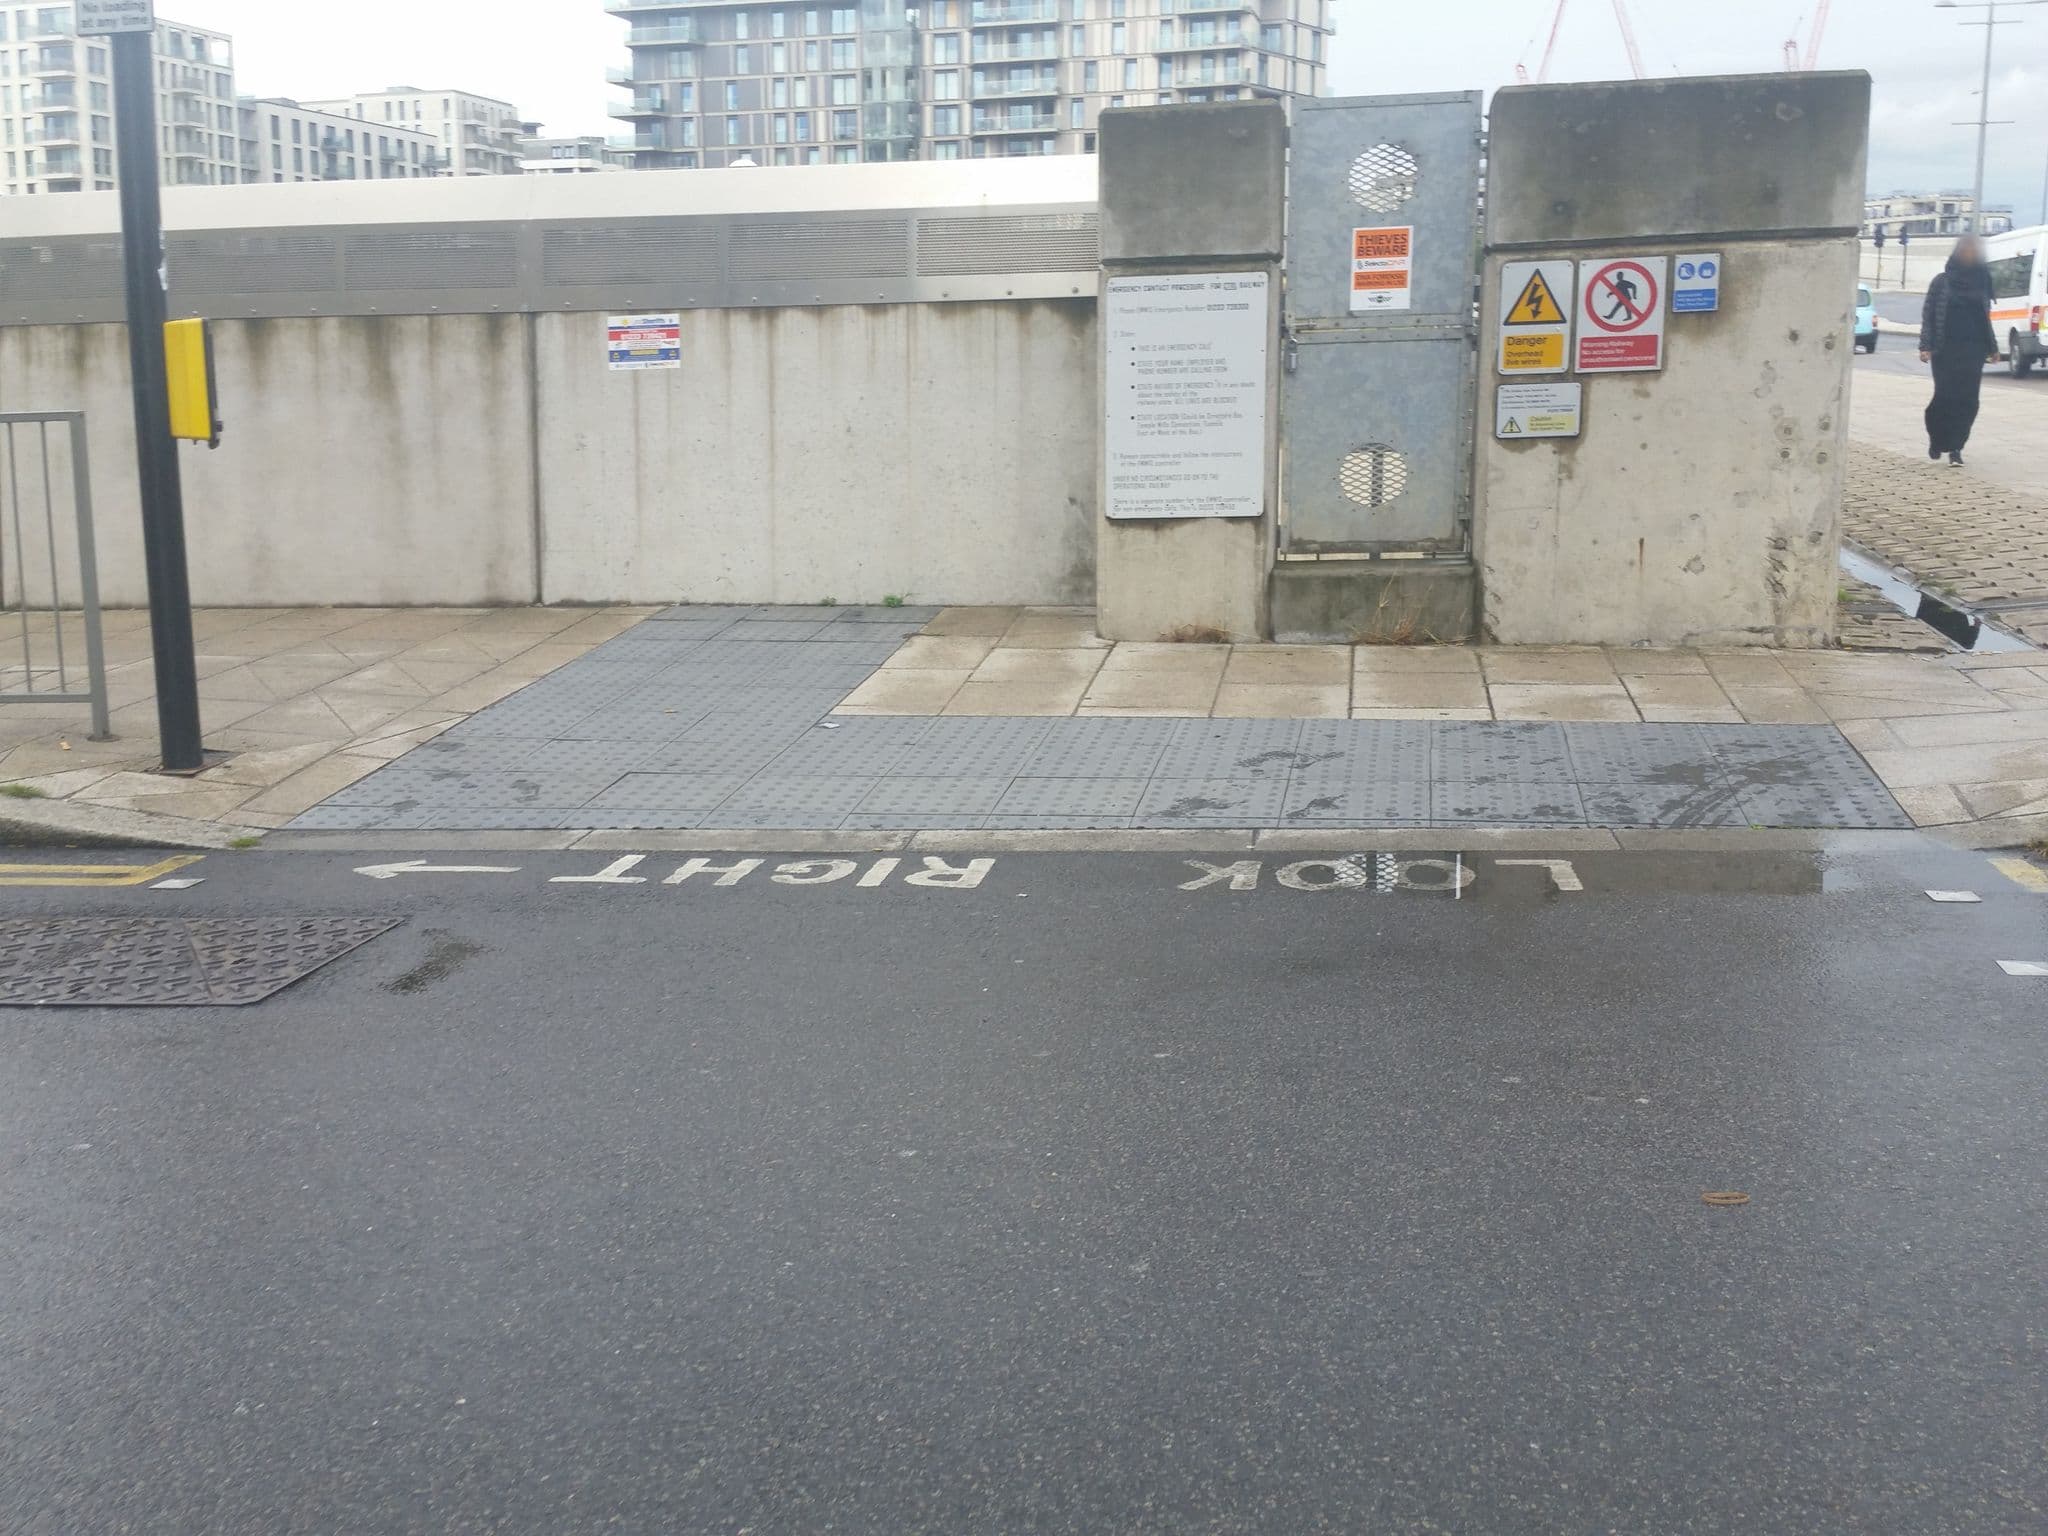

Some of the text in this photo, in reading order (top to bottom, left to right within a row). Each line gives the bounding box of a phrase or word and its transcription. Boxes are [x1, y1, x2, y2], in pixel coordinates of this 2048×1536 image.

[1358, 233, 1408, 245] THIEVES
[1356, 245, 1407, 256] BEWARE
[1506, 335, 1548, 347] Danger
[1506, 349, 1544, 358] Overhead
[547, 853, 997, 890] RIGHT
[1177, 858, 1585, 892] LOOK
